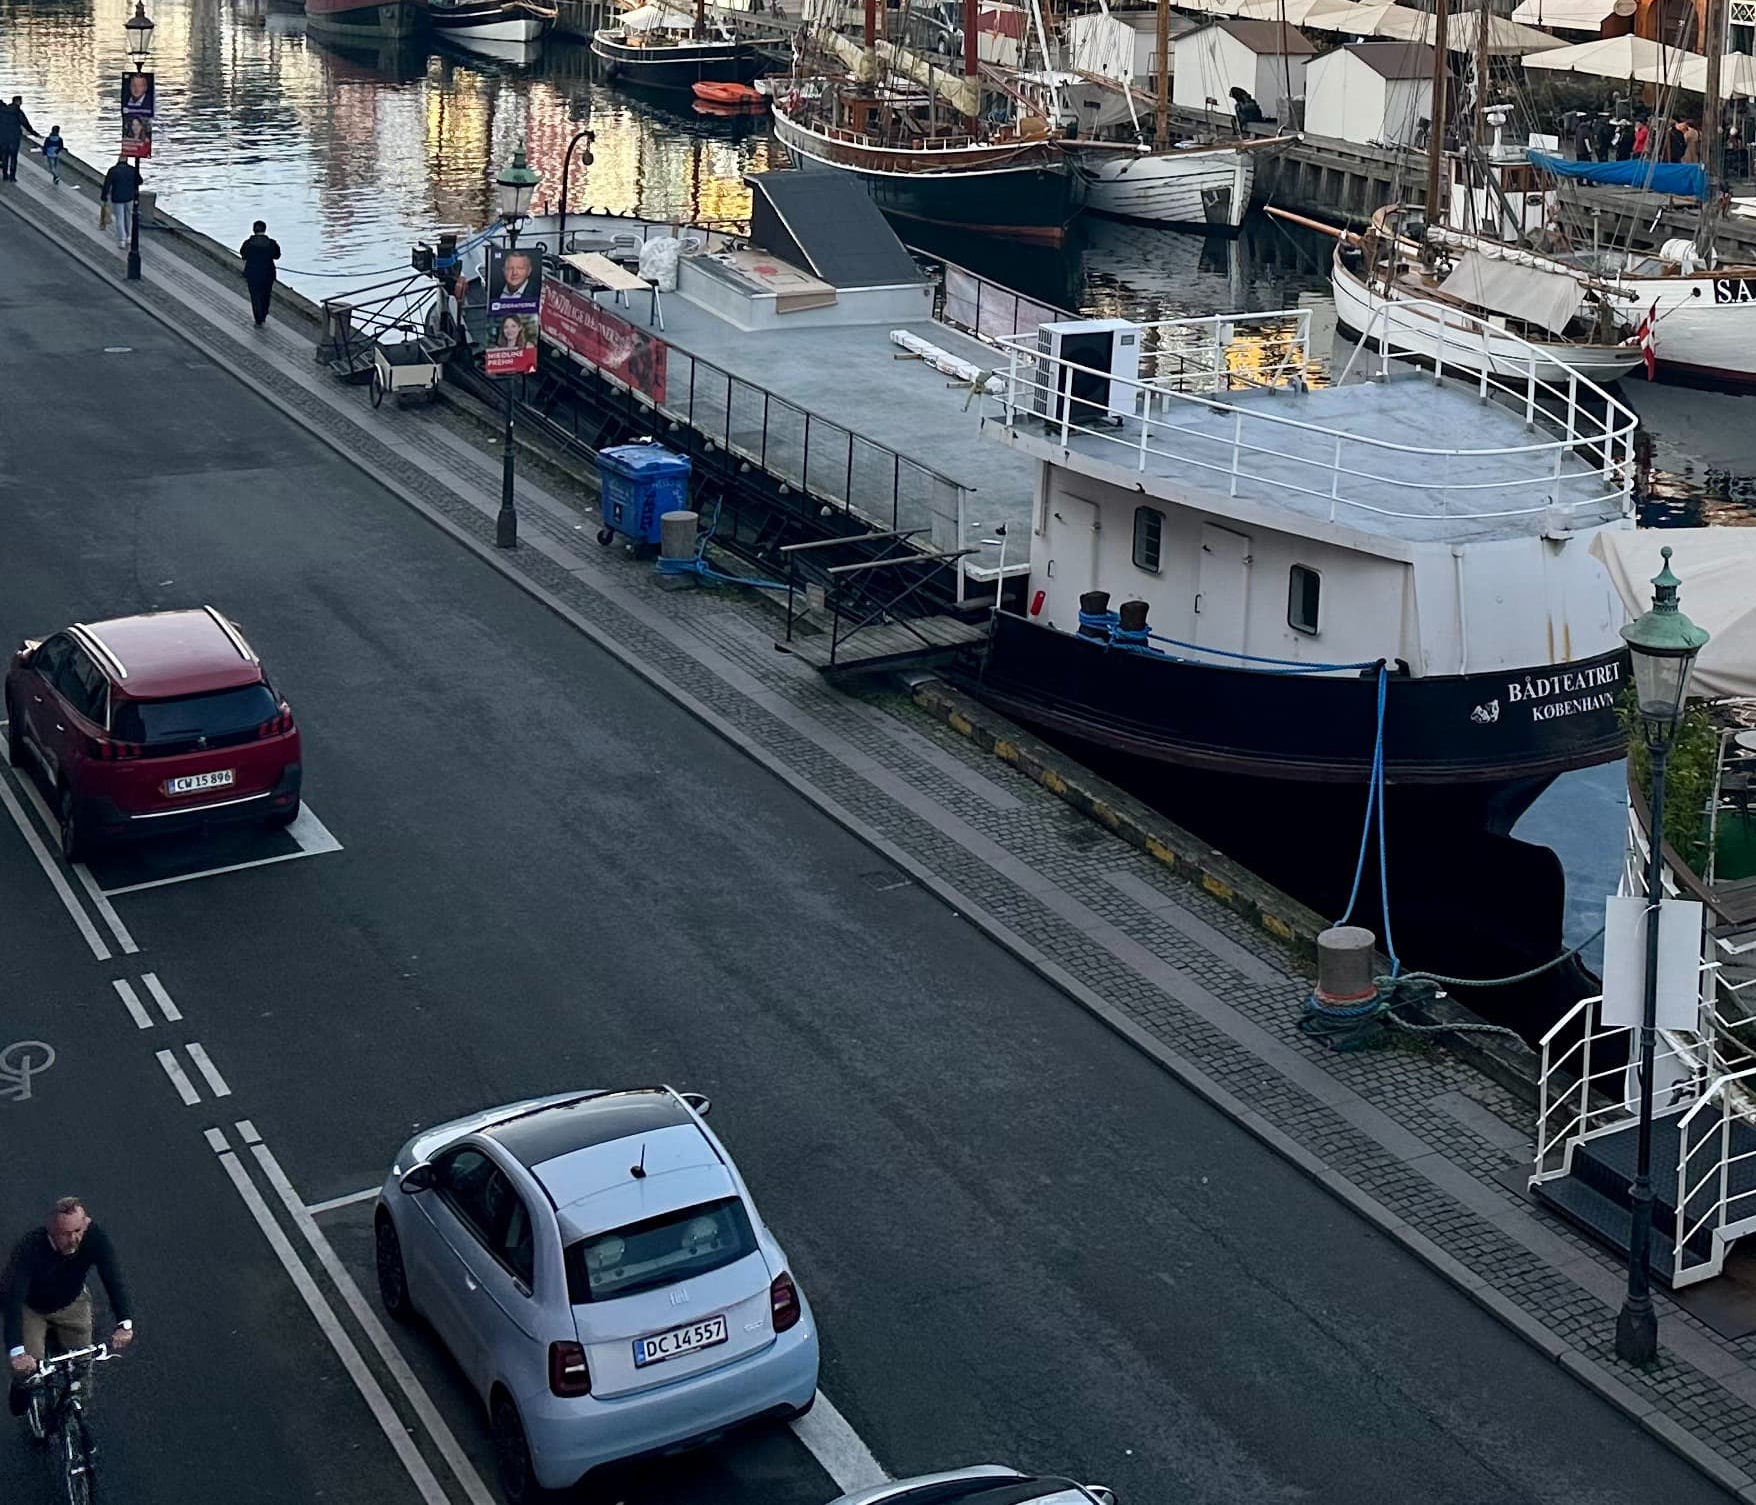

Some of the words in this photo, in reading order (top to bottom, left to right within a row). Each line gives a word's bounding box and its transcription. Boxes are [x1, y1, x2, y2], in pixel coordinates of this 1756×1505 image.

[1507, 661, 1621, 703] BÅDTEATRET
[1532, 692, 1614, 722] KØBENHAVN
[196, 775, 208, 787] 15
[210, 771, 231, 784] 896
[646, 1336, 669, 1358] DC
[671, 1329, 692, 1350] 14
[693, 1320, 722, 1344] 557
